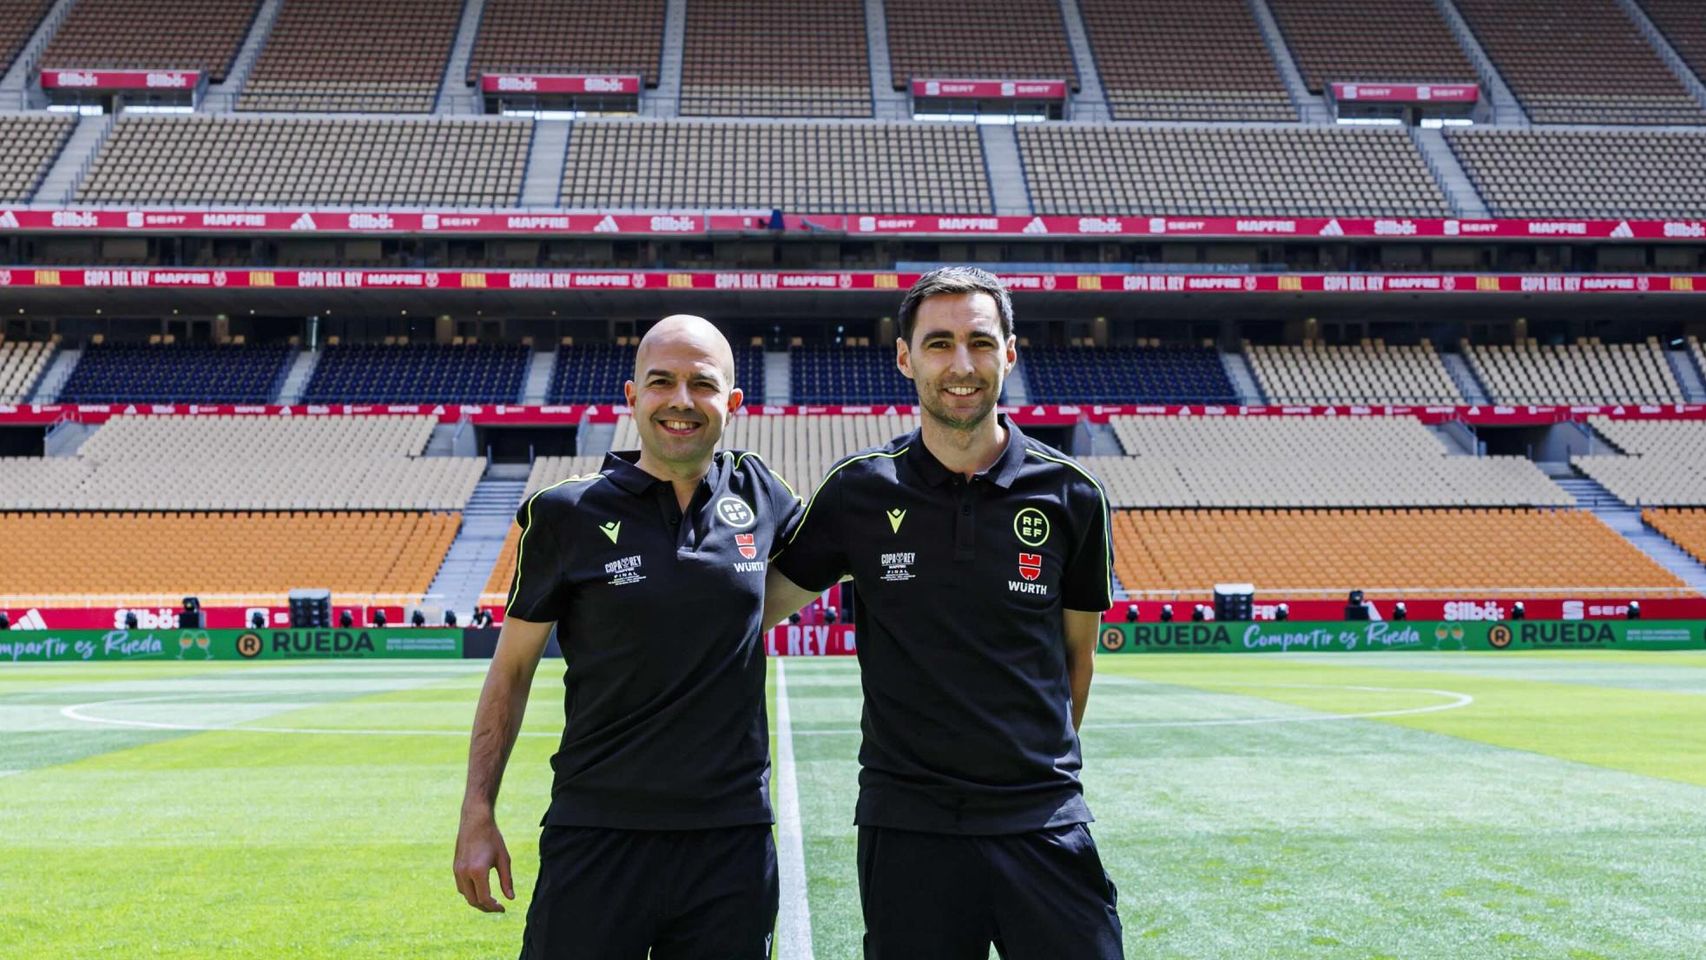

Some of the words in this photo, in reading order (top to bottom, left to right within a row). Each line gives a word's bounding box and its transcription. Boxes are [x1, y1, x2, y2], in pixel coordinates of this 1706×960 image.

[204, 214, 266, 226] MAPFRE
[508, 217, 569, 228] MAPFRE
[938, 218, 998, 230] MAPFRE
[1236, 220, 1295, 232] MAPFRE
[1528, 222, 1586, 234] MAPFRE
[84, 270, 110, 286] COPA
[112, 270, 128, 286] DEL
[131, 270, 149, 286] REY
[154, 272, 209, 284] MAPFRE
[298, 271, 324, 286] COPA
[326, 271, 342, 286] DEL
[344, 271, 362, 286] REY
[367, 274, 422, 285] MAPFRE
[510, 272, 533, 288] COPA
[534, 272, 550, 288] DEL
[552, 272, 570, 288] REY
[576, 275, 629, 286] MAPFRE
[716, 274, 740, 289] COPA
[742, 274, 758, 289] DEL
[760, 274, 778, 289] REY
[782, 276, 836, 286] MAPFRE
[998, 276, 1040, 288] APFRE
[1123, 276, 1148, 290] COPA
[1150, 276, 1165, 290] DEL
[1167, 276, 1184, 290] REY
[1188, 278, 1241, 288] MAPFRE
[1324, 276, 1348, 290] COPA
[1349, 276, 1364, 290] DEL
[1366, 276, 1384, 290] REY
[1388, 278, 1440, 288] MAPFRE
[1521, 276, 1544, 290] COPA
[1546, 276, 1562, 290] DEL
[1564, 276, 1580, 290] REY
[1583, 278, 1634, 288] MAPFRE
[605, 560, 622, 573] COPA
[629, 555, 642, 567] REY
[882, 554, 896, 565] COPA
[904, 552, 916, 564] REY
[1588, 606, 1629, 615] SEA
[1134, 625, 1232, 646] RUEDA
[1244, 624, 1333, 652] Compartir
[1339, 632, 1359, 650] es
[1364, 622, 1421, 646] Rueda
[1521, 623, 1616, 643] RUEDA
[74, 640, 97, 658] es
[102, 630, 162, 656] Rueda
[272, 631, 374, 652] RUEDA
[787, 625, 830, 656] REY
